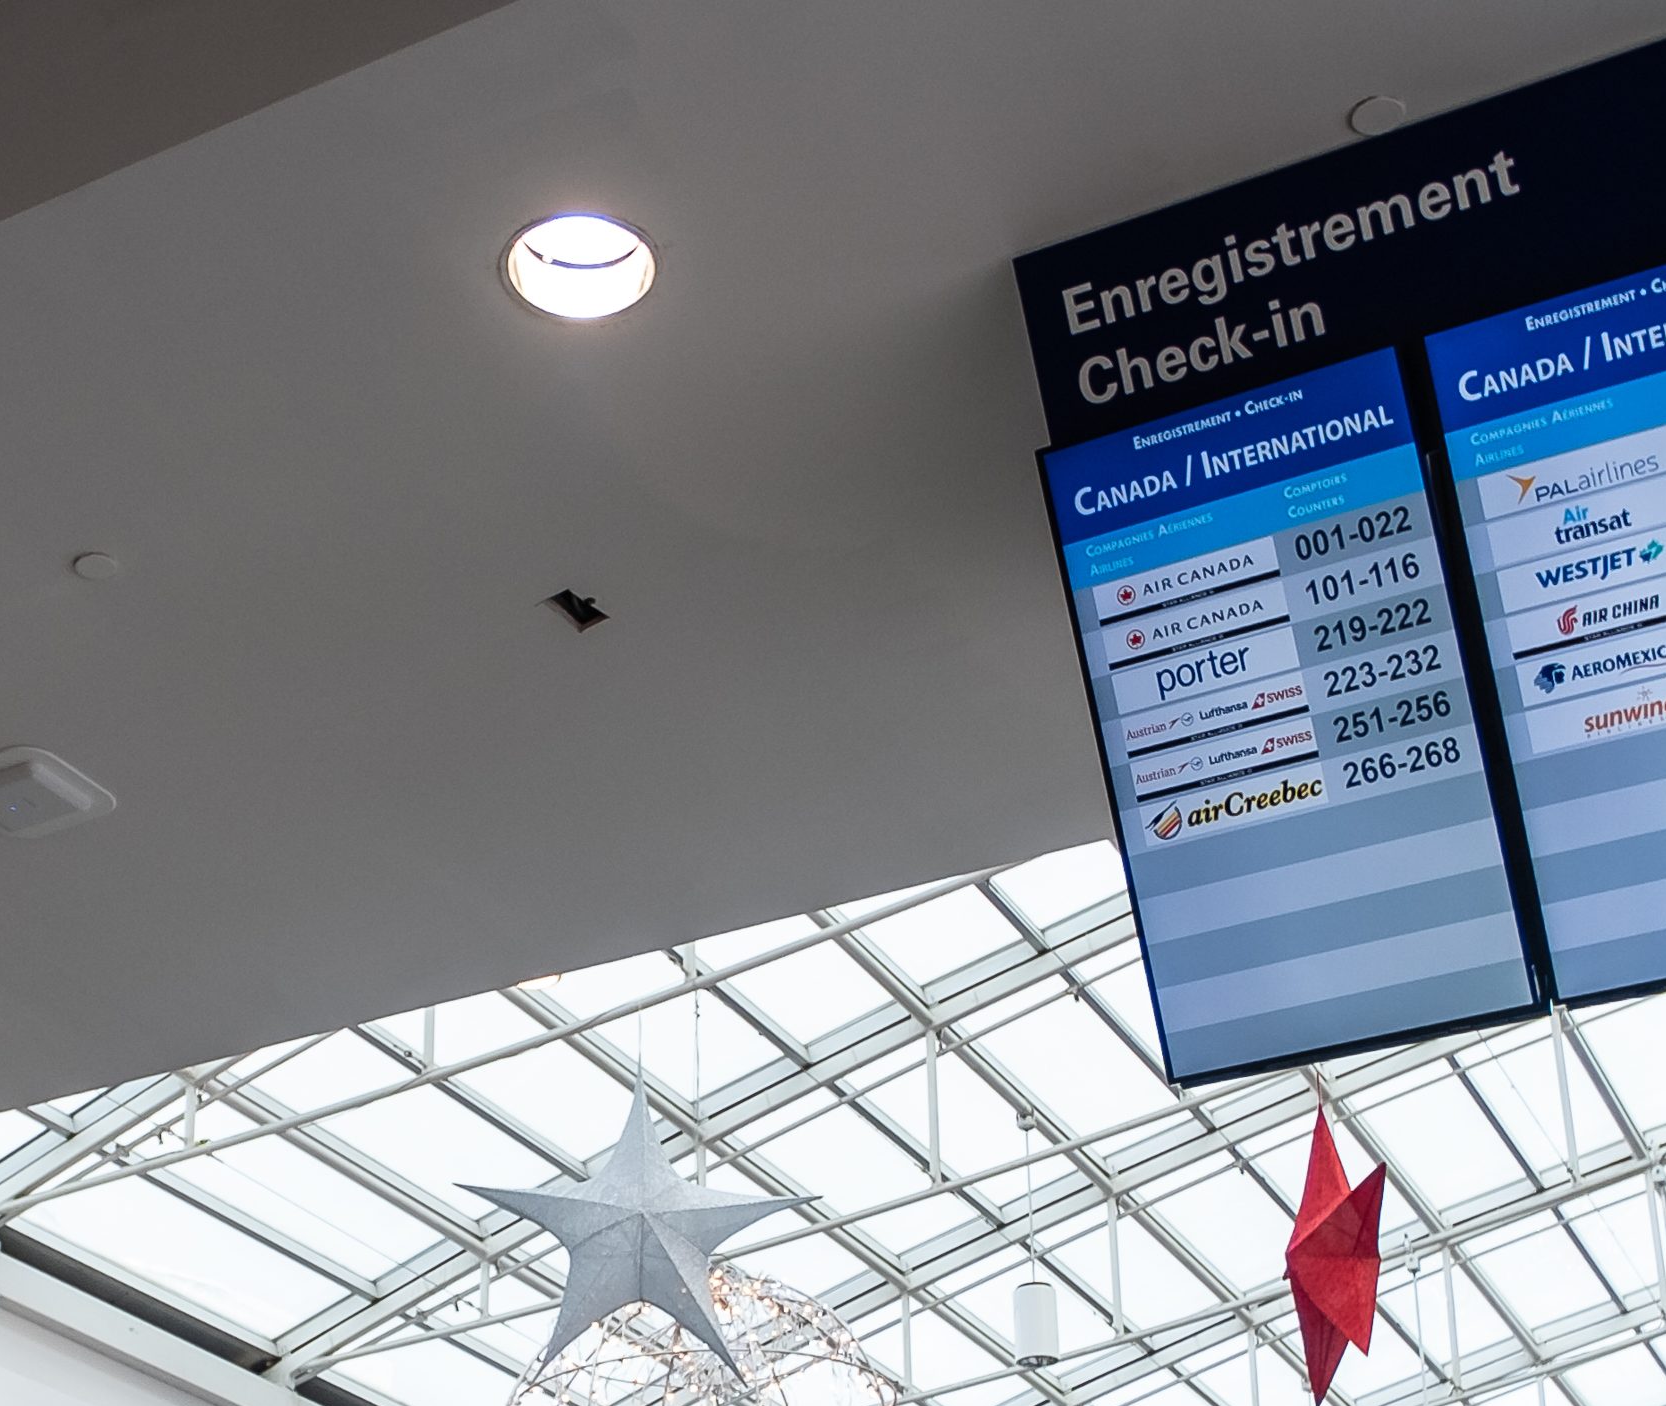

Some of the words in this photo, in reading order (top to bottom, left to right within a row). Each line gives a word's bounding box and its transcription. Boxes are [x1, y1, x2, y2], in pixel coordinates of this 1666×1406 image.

[1061, 150, 1522, 337] Enregistrement
[1077, 295, 1327, 405] Check-in
[1293, 505, 1413, 561] 001-022
[1554, 509, 1633, 545] transat
[1562, 505, 1590, 526] Air
[1142, 577, 1174, 597] AIR
[1176, 554, 1255, 587] CANADA
[1304, 552, 1421, 606] 101-116
[1535, 548, 1638, 589] WESTJET
[1152, 621, 1183, 641] AIR
[1186, 599, 1265, 631] CANADA
[1313, 598, 1433, 654] 219-222
[1582, 607, 1609, 627] AIR
[1612, 594, 1660, 620] CHINA
[1155, 645, 1250, 700] porter
[1323, 644, 1443, 698] 223-232
[1126, 719, 1168, 741] Austrian
[1199, 700, 1248, 722] Lufthansa
[1266, 684, 1303, 705] SWISS
[1332, 690, 1452, 744] 251-256
[1135, 764, 1177, 786] Austrian
[1208, 745, 1258, 766] Lufthansa
[1276, 729, 1313, 750] SWISS
[1342, 736, 1462, 789] 266-268
[1186, 776, 1324, 829] airCreebec
